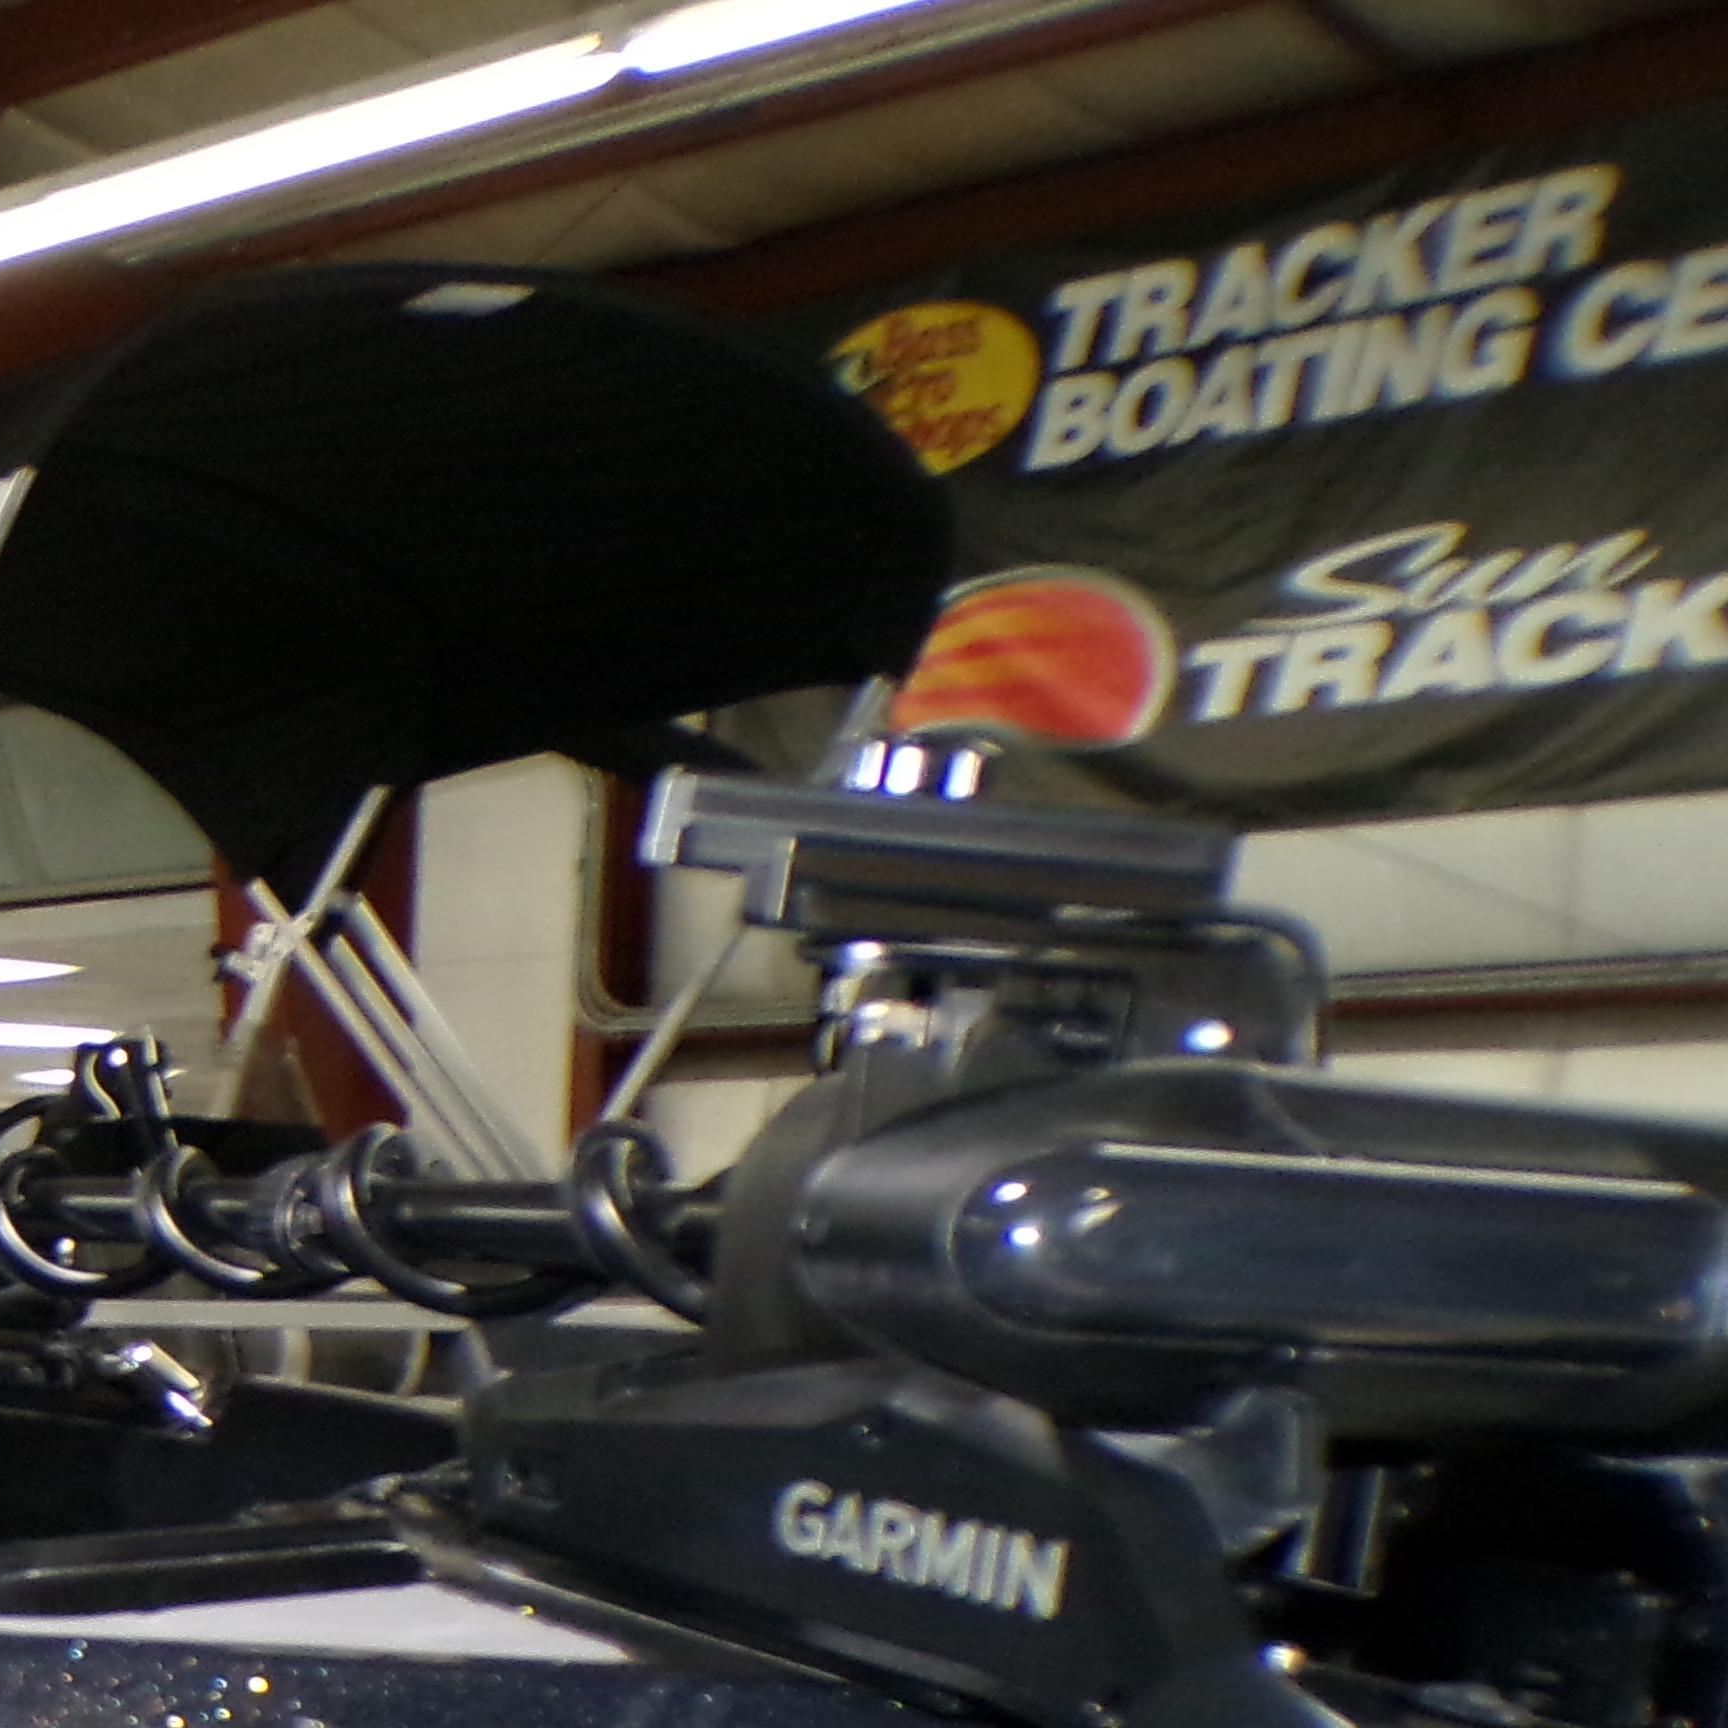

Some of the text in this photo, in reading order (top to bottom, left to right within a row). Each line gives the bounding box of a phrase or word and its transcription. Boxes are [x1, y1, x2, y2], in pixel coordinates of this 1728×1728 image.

[1047, 165, 1621, 370] TRACKER
[1025, 287, 1542, 472] BOATING
[1250, 520, 1663, 631] Sun
[775, 1479, 1072, 1620] GARMIN
